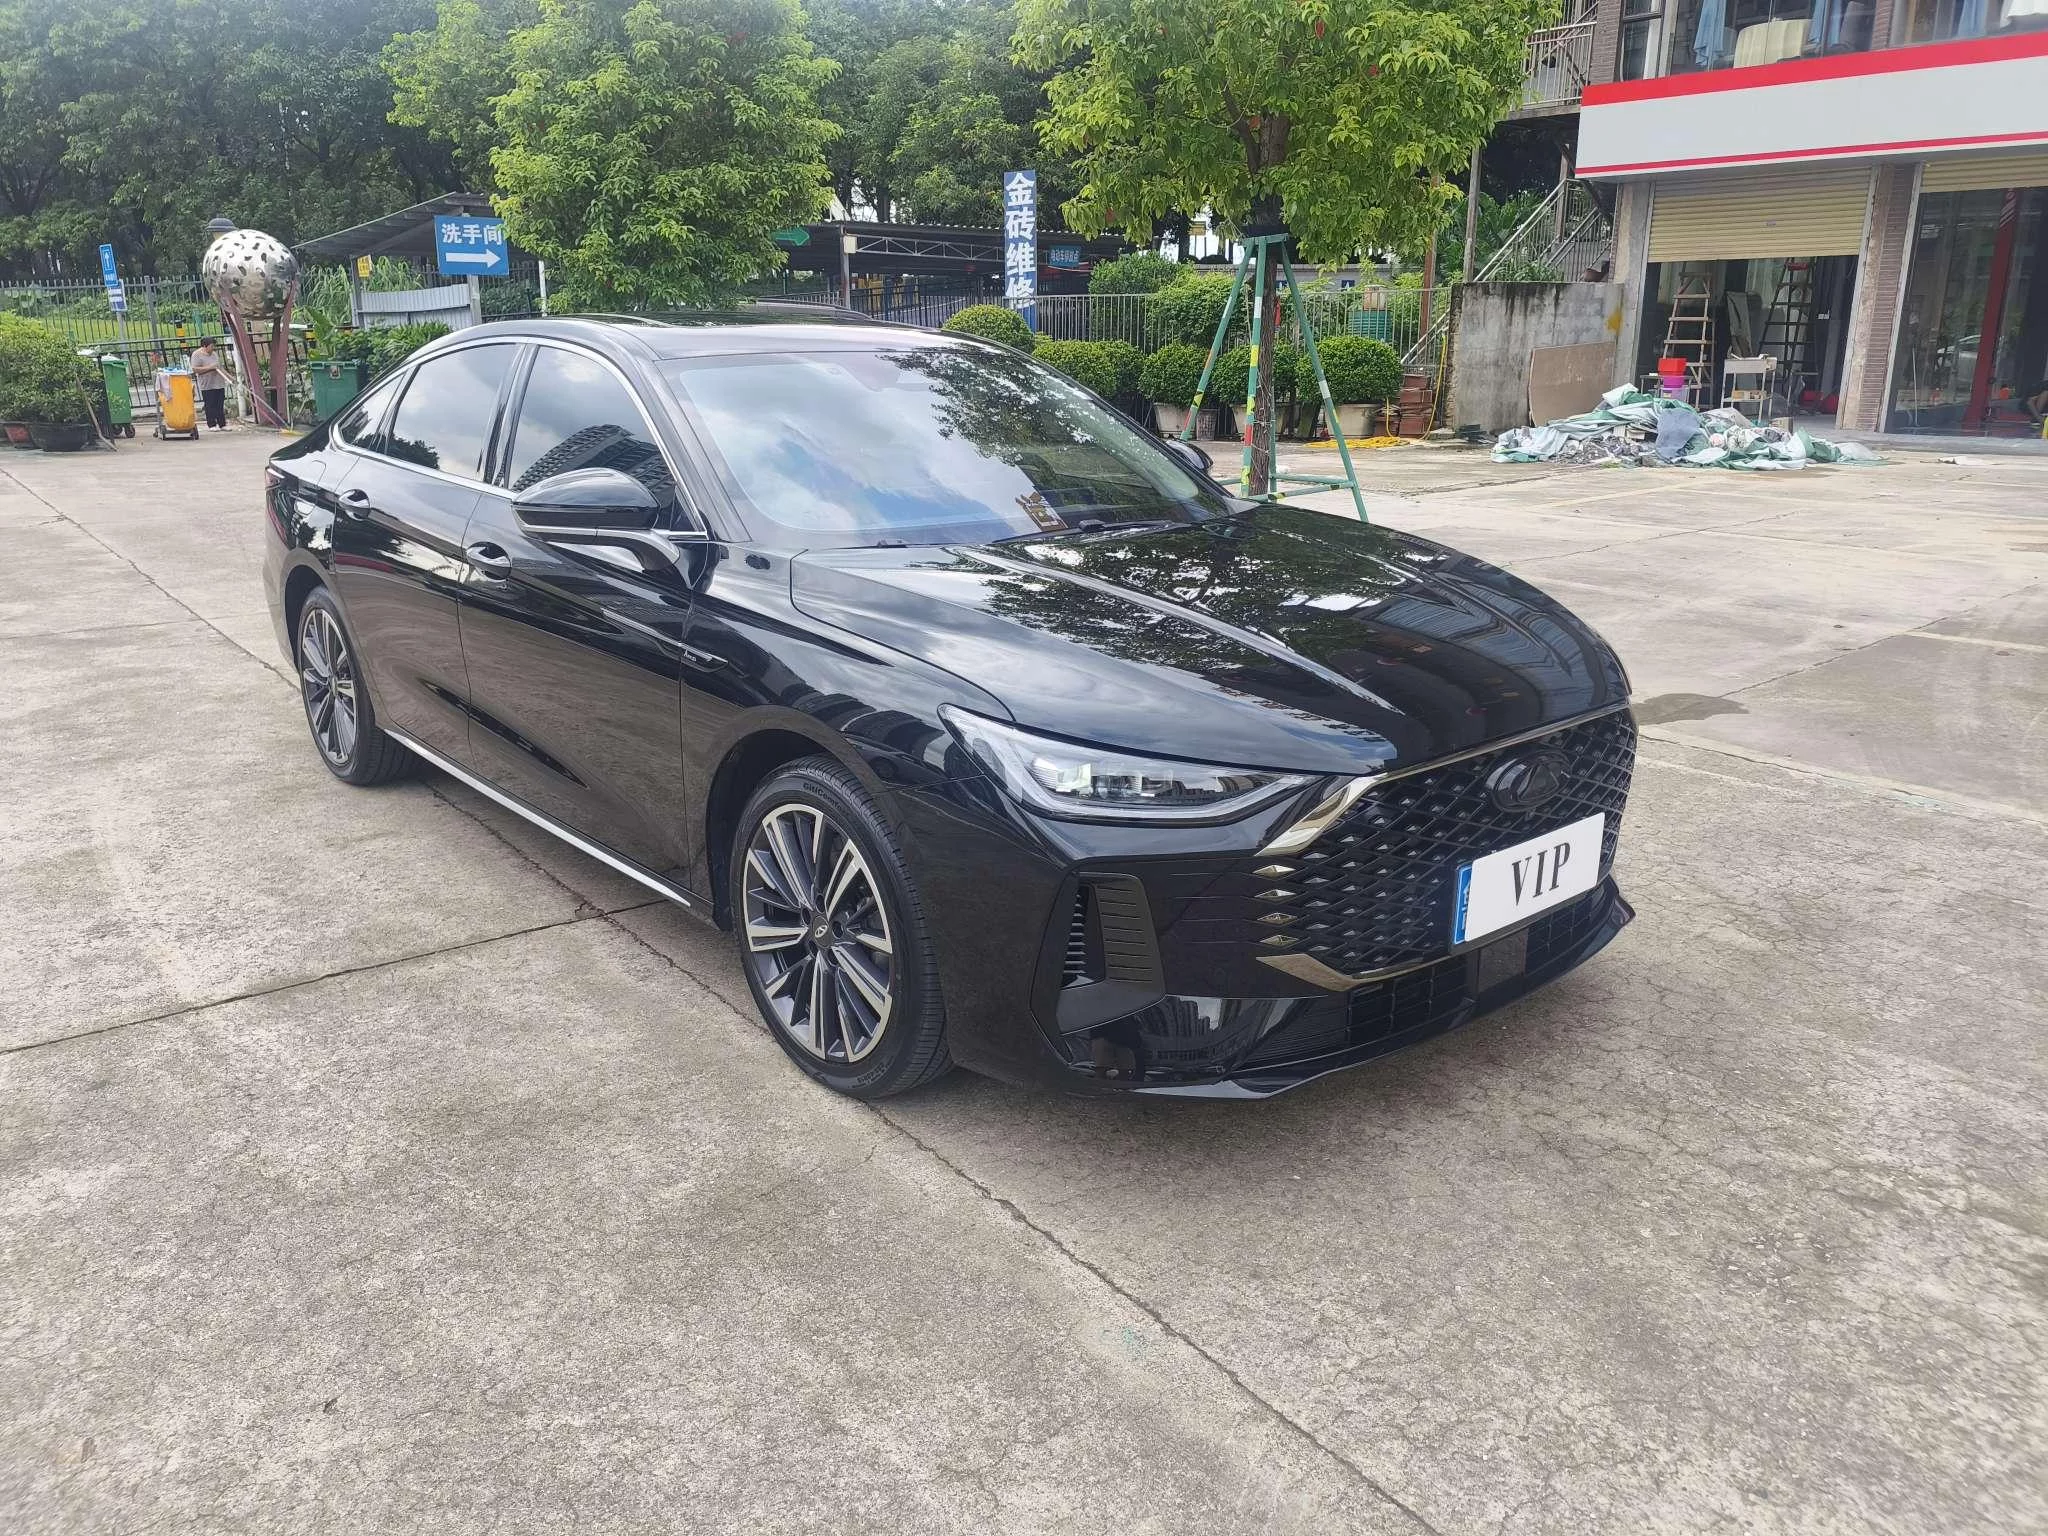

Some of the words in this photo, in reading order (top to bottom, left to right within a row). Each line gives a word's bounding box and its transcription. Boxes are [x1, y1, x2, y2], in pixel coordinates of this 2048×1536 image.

[441, 223, 503, 245] 洗手间
[1005, 172, 1036, 310] 金砖维修
[1512, 842, 1571, 906] VIP
